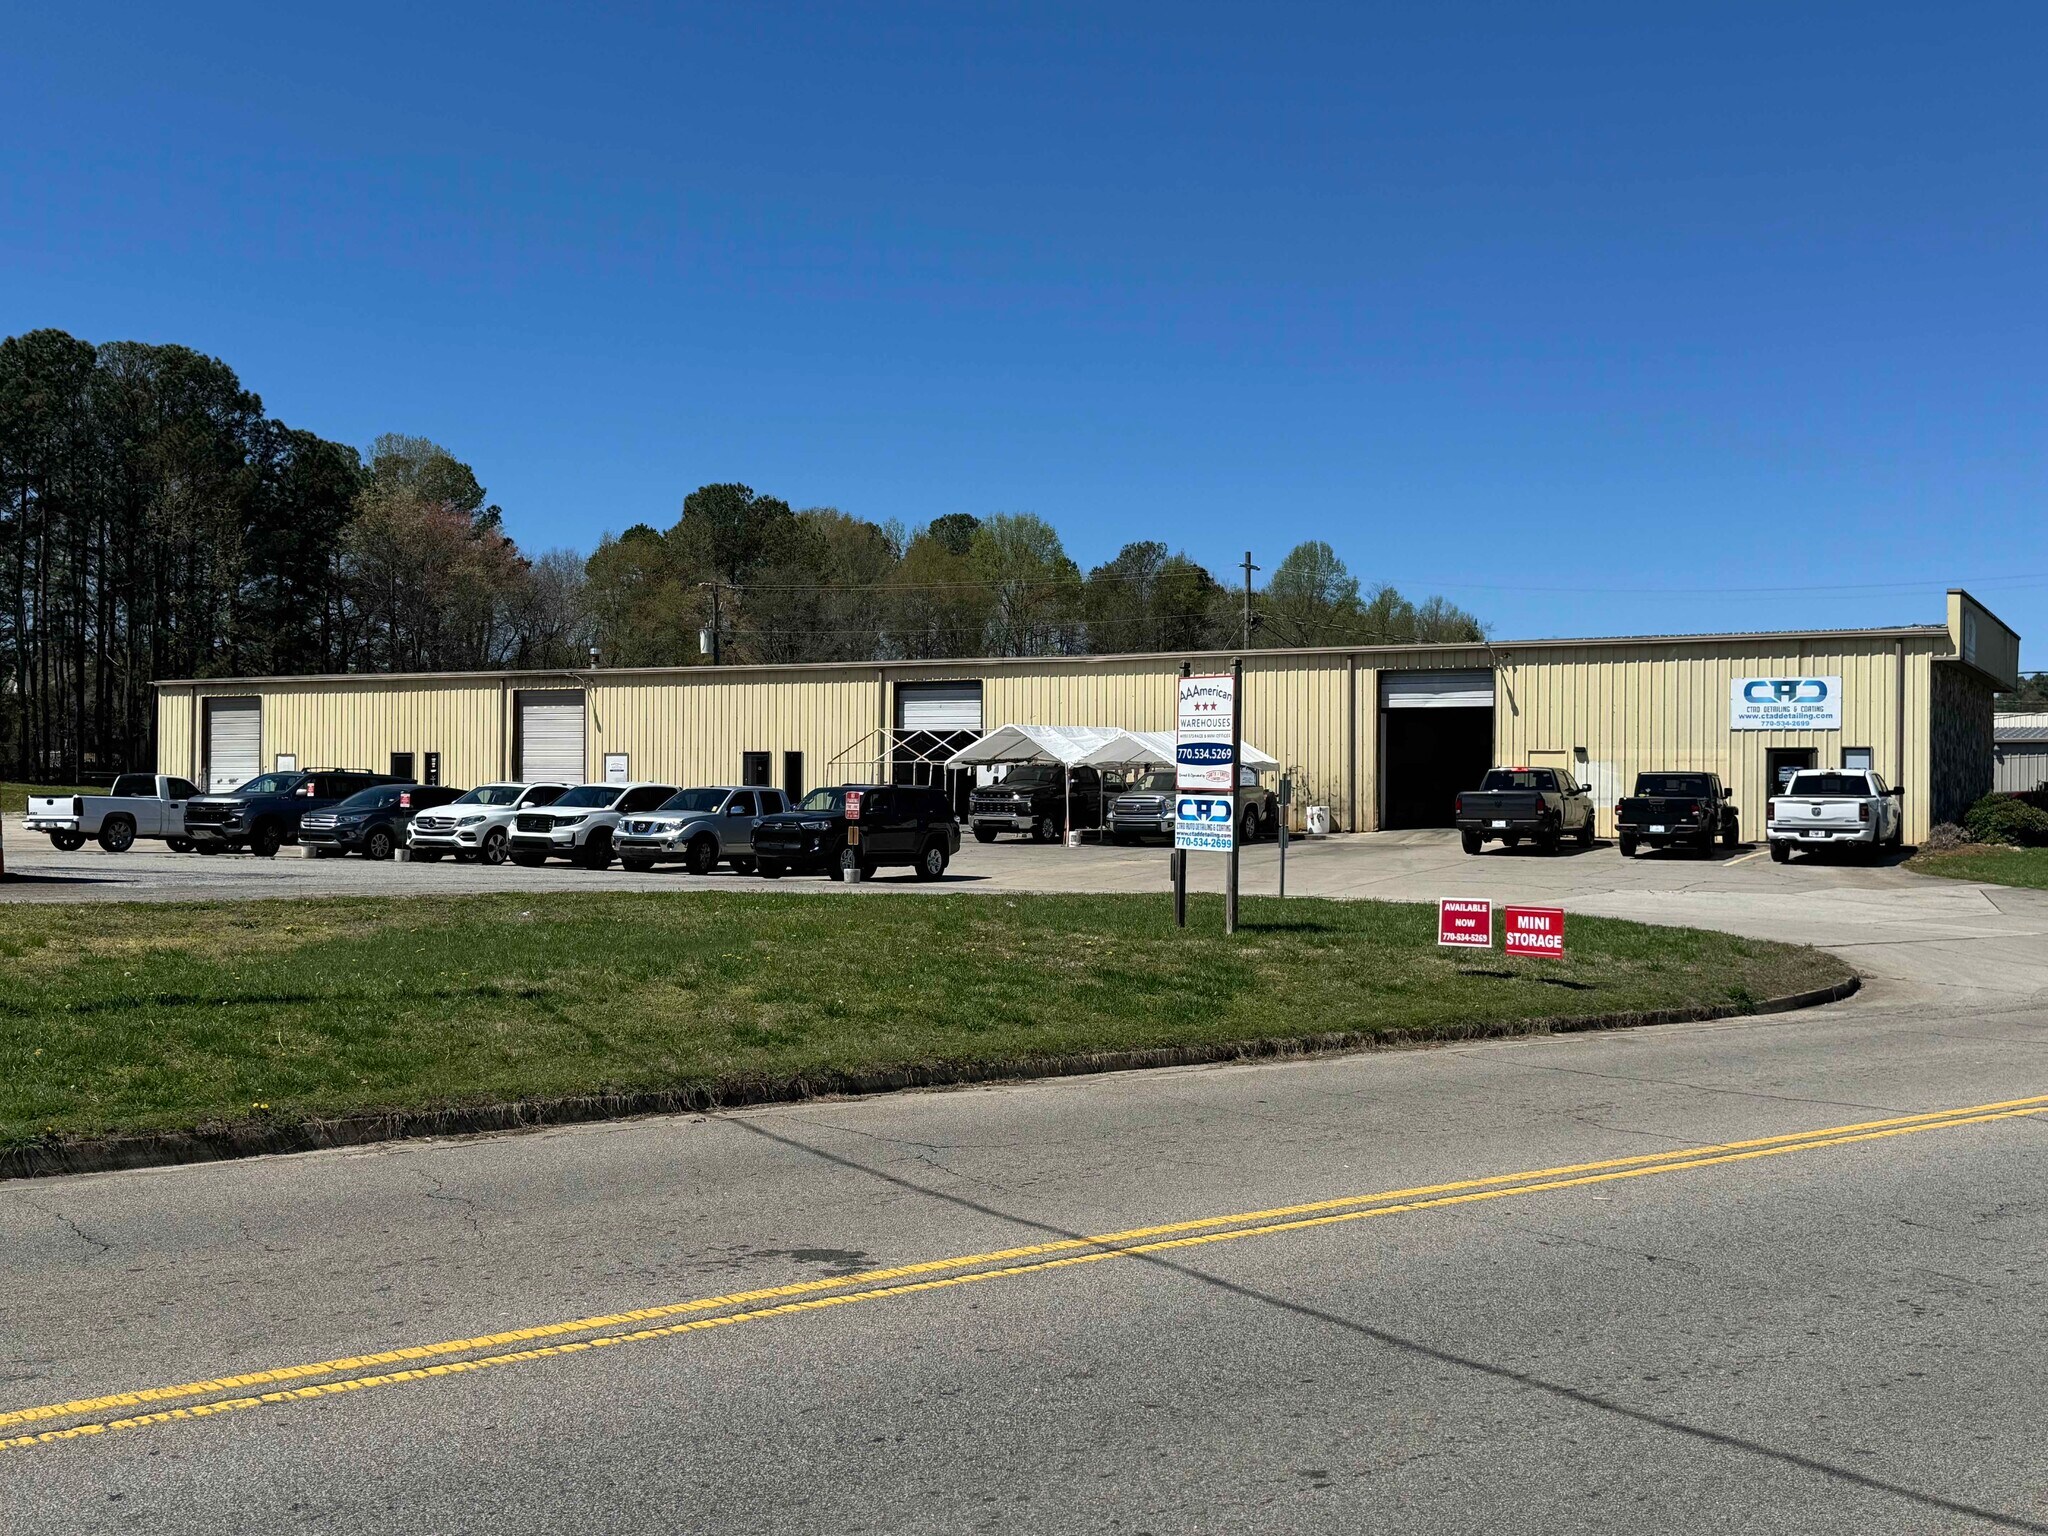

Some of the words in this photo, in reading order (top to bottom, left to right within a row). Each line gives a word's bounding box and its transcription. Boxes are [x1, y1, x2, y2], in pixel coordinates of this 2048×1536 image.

[1180, 685, 1232, 702] AAAmerican
[1739, 712, 1833, 720] www.ctaddetailing.com
[1181, 718, 1230, 727] WAREHOUSES
[1177, 749, 1232, 759] 770.534.5269
[1176, 837, 1232, 848] 770-534-2699
[1444, 903, 1487, 912] AVAILABLE
[1455, 918, 1475, 927] NOW
[1517, 916, 1549, 930] MINI
[1442, 932, 1487, 942] 770-534-5269
[1506, 932, 1562, 948] STORAGE
